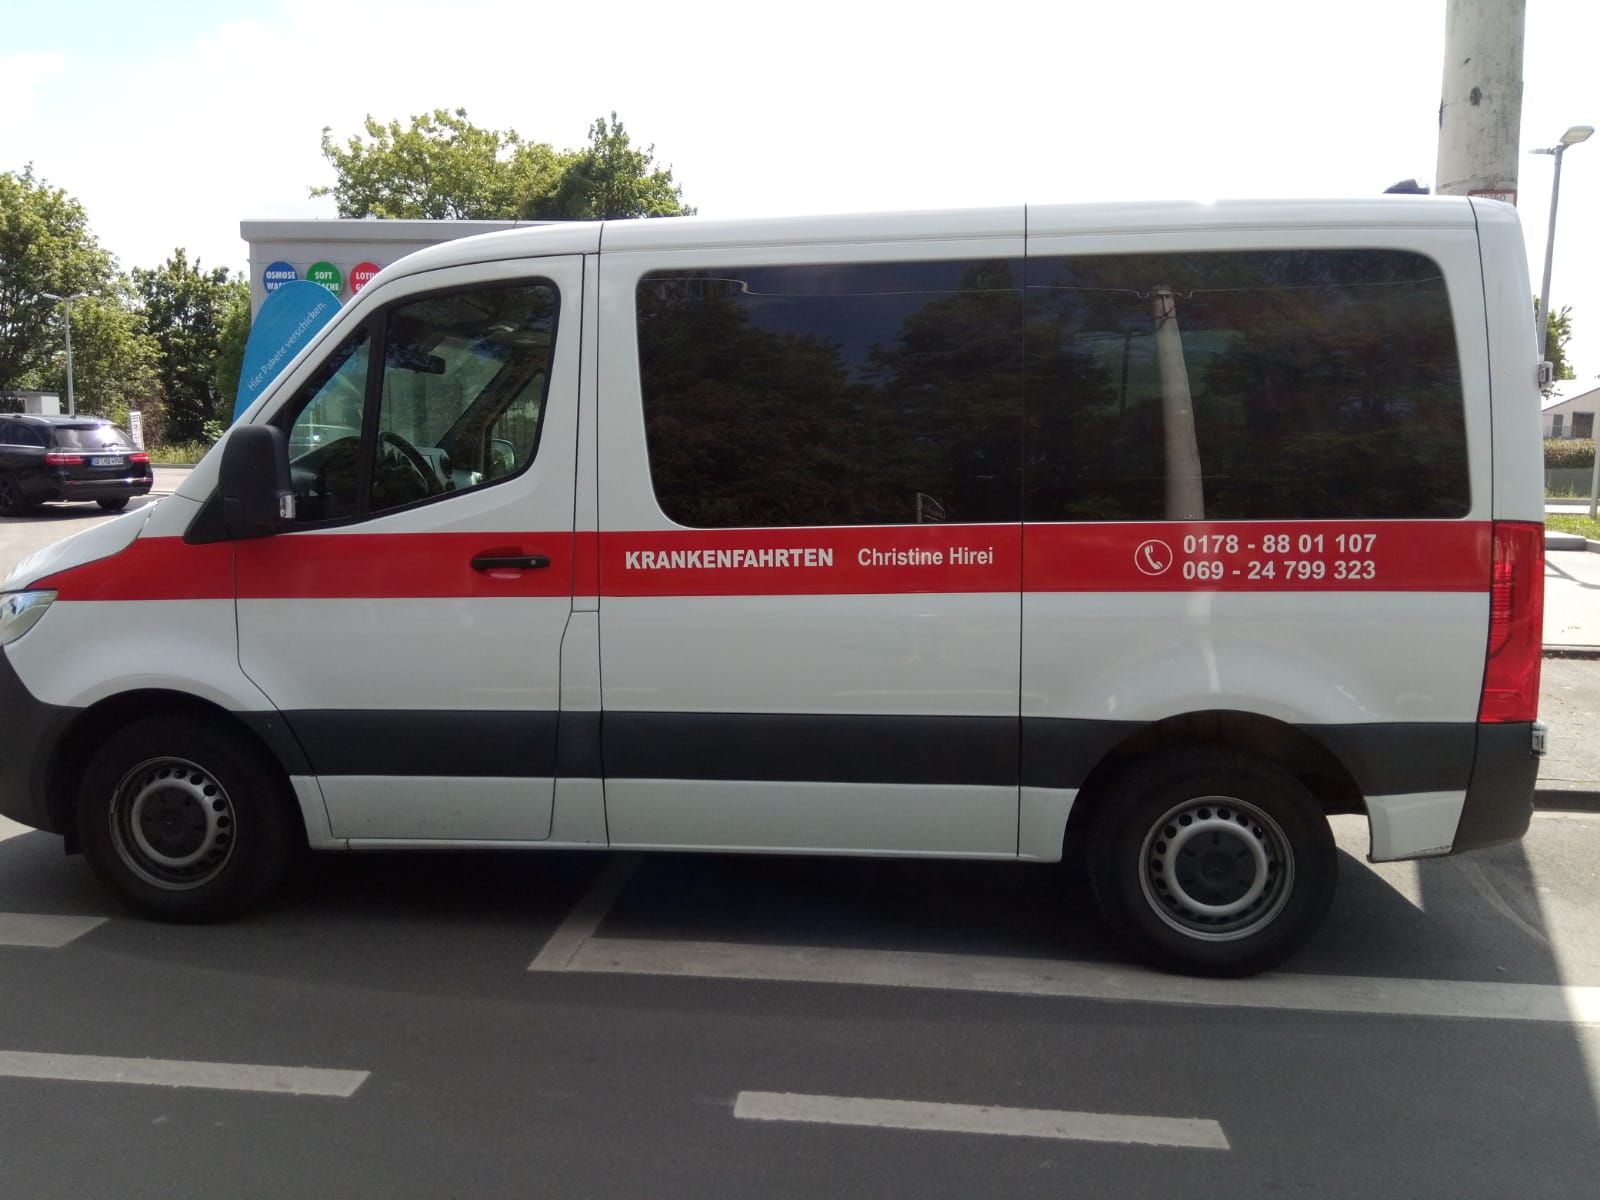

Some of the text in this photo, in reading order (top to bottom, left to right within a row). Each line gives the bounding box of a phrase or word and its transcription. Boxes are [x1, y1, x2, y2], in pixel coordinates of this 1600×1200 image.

[265, 271, 296, 280] OSMOSE
[314, 271, 333, 280] SOFT
[247, 301, 327, 391] Hier Pakete verschicken.
[1182, 534, 1240, 554] 0178
[1262, 534, 1291, 554] 88
[1297, 533, 1325, 554] 01
[1334, 533, 1378, 553] 107
[624, 546, 994, 570] KRANKENFAHRTEN Christine Hirei
[1182, 560, 1225, 580] 069
[1246, 560, 1276, 580] 24
[1282, 560, 1327, 580] 799
[1333, 560, 1377, 580] 323
